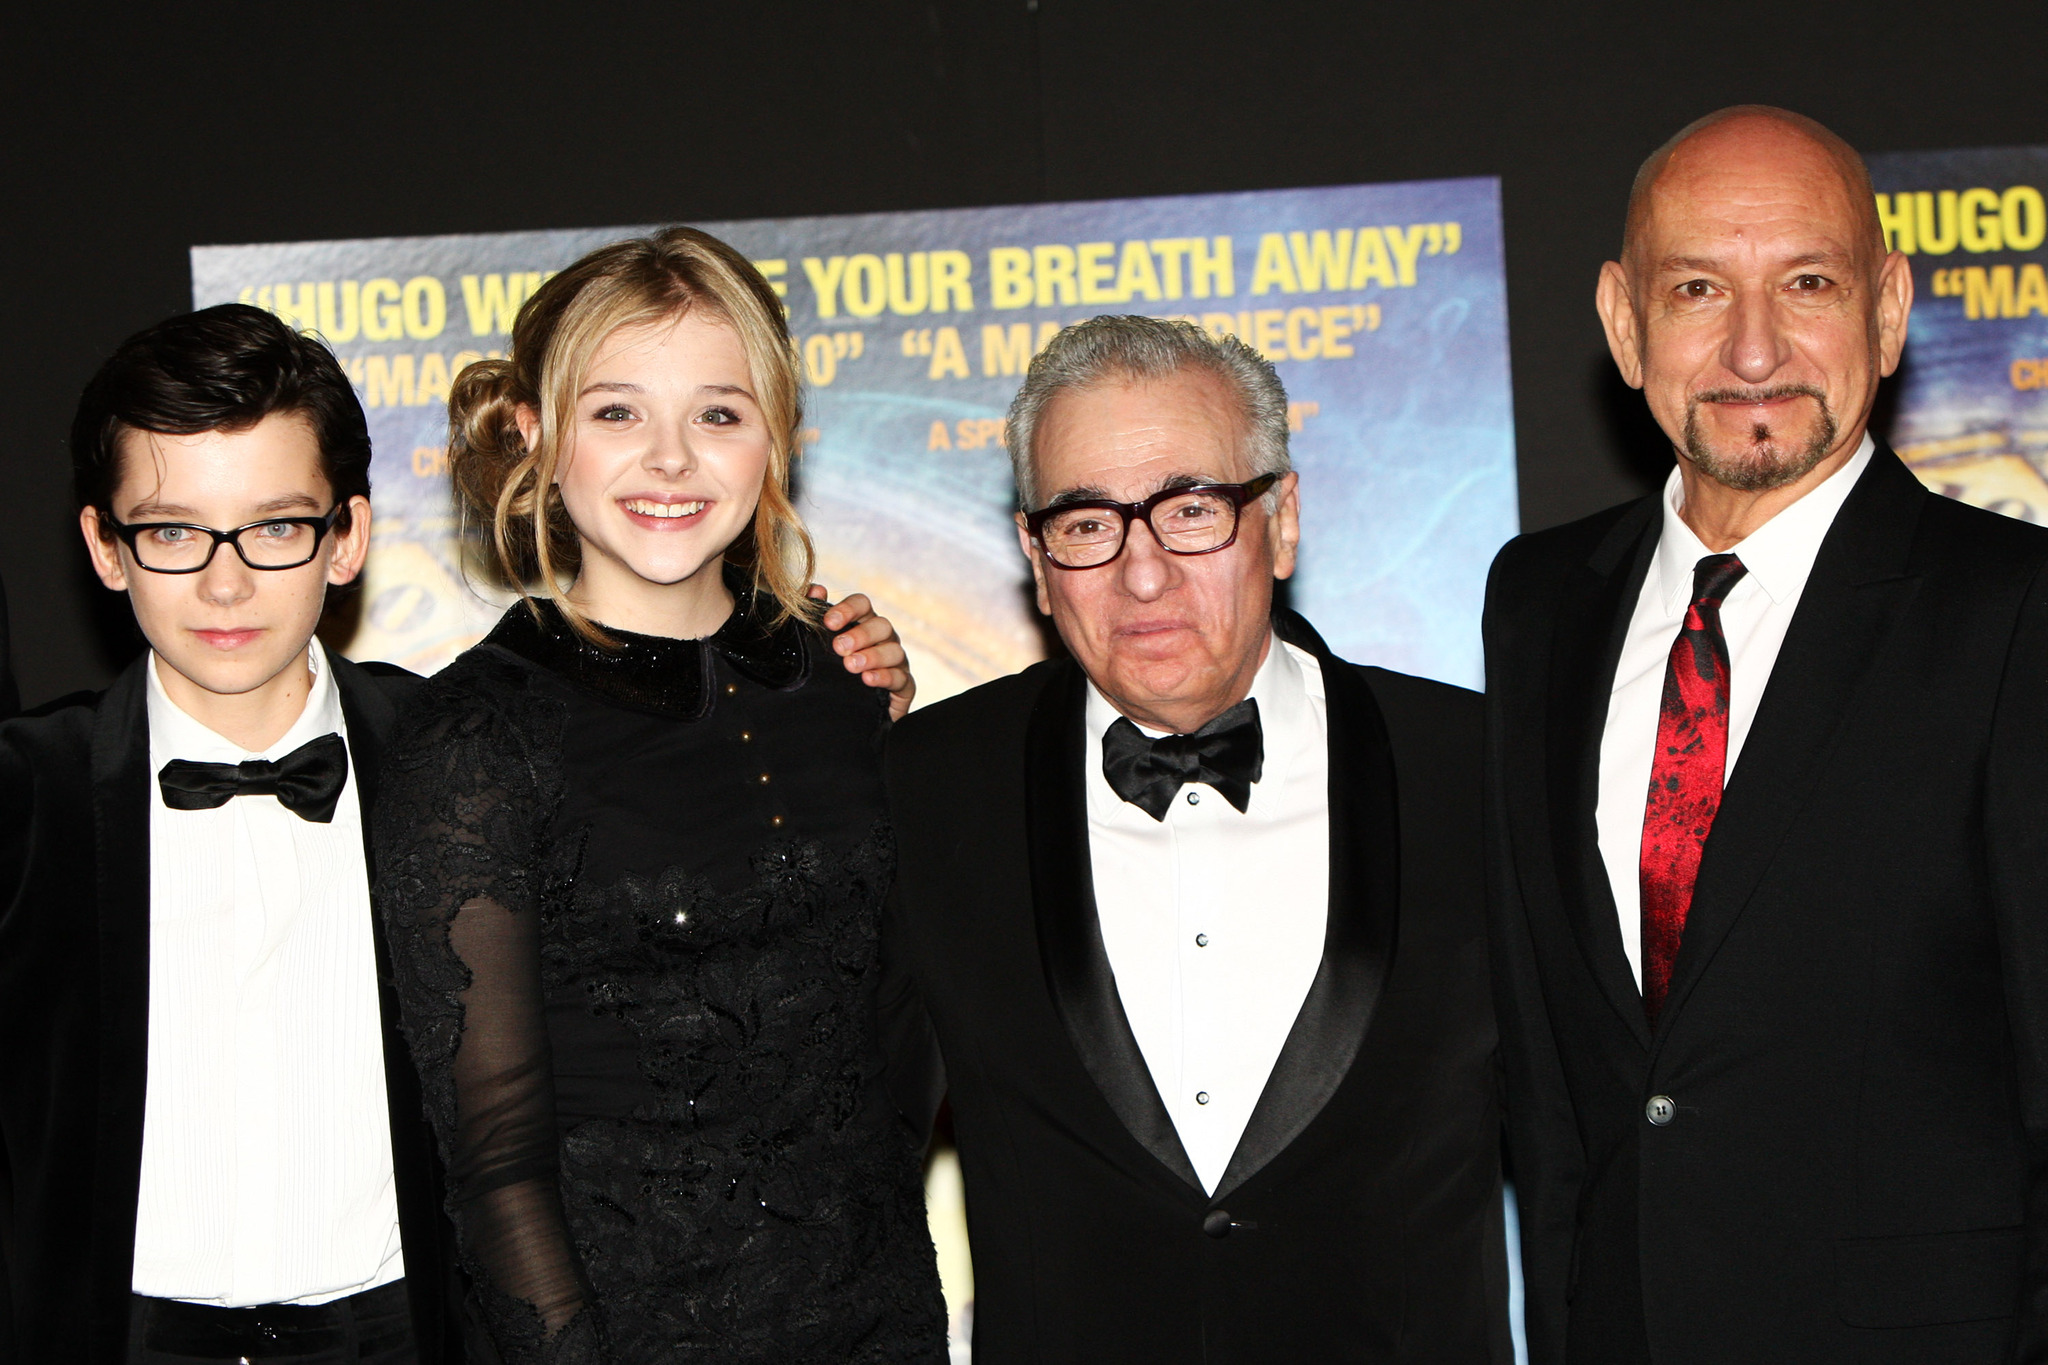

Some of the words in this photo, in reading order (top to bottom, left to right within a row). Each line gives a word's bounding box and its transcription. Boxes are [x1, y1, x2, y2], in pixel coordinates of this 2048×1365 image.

[1876, 185, 2046, 257] HUGO
[801, 249, 975, 319] YOUR
[989, 235, 1235, 310] BREATH
[1251, 221, 1462, 295] AWAY”
[901, 326, 971, 381] “A
[927, 419, 953, 451] A
